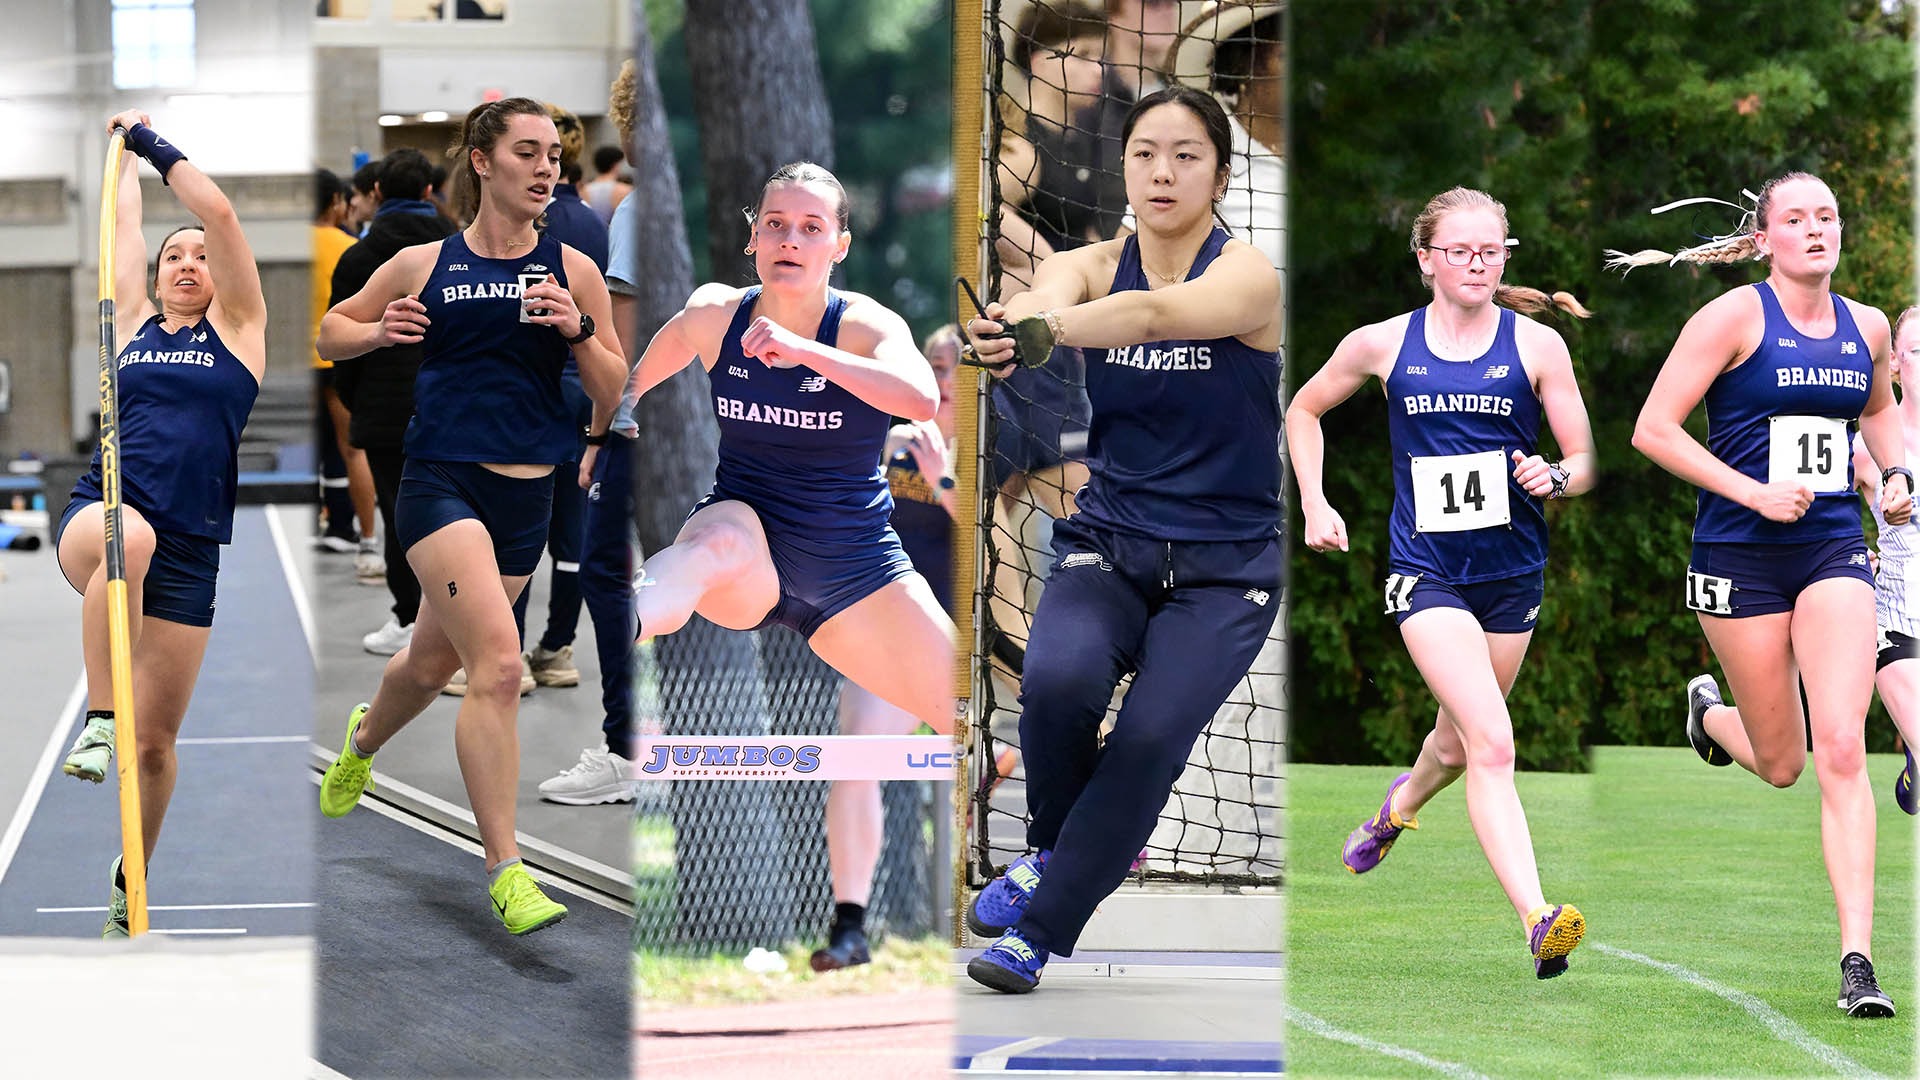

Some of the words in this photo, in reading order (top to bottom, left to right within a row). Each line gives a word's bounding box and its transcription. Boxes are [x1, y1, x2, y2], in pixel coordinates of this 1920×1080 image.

[448, 264, 469, 272] UAA
[442, 283, 521, 304] BRAND
[1777, 338, 1798, 348] UAA
[118, 350, 215, 371] BRANDEIS
[1406, 365, 1429, 376] UAA
[728, 365, 750, 380] UAA
[1776, 367, 1868, 392] BRANDEIS
[716, 396, 844, 430] BRANDEIS
[1403, 394, 1514, 417] BRANDEIS
[1797, 433, 1832, 475] 15
[1440, 470, 1486, 514] 14
[447, 581, 457, 598] B
[1688, 574, 1718, 611] 15
[641, 744, 822, 774] JUMBOS
[906, 753, 959, 768] UC
[1007, 863, 1042, 894] NIKE
